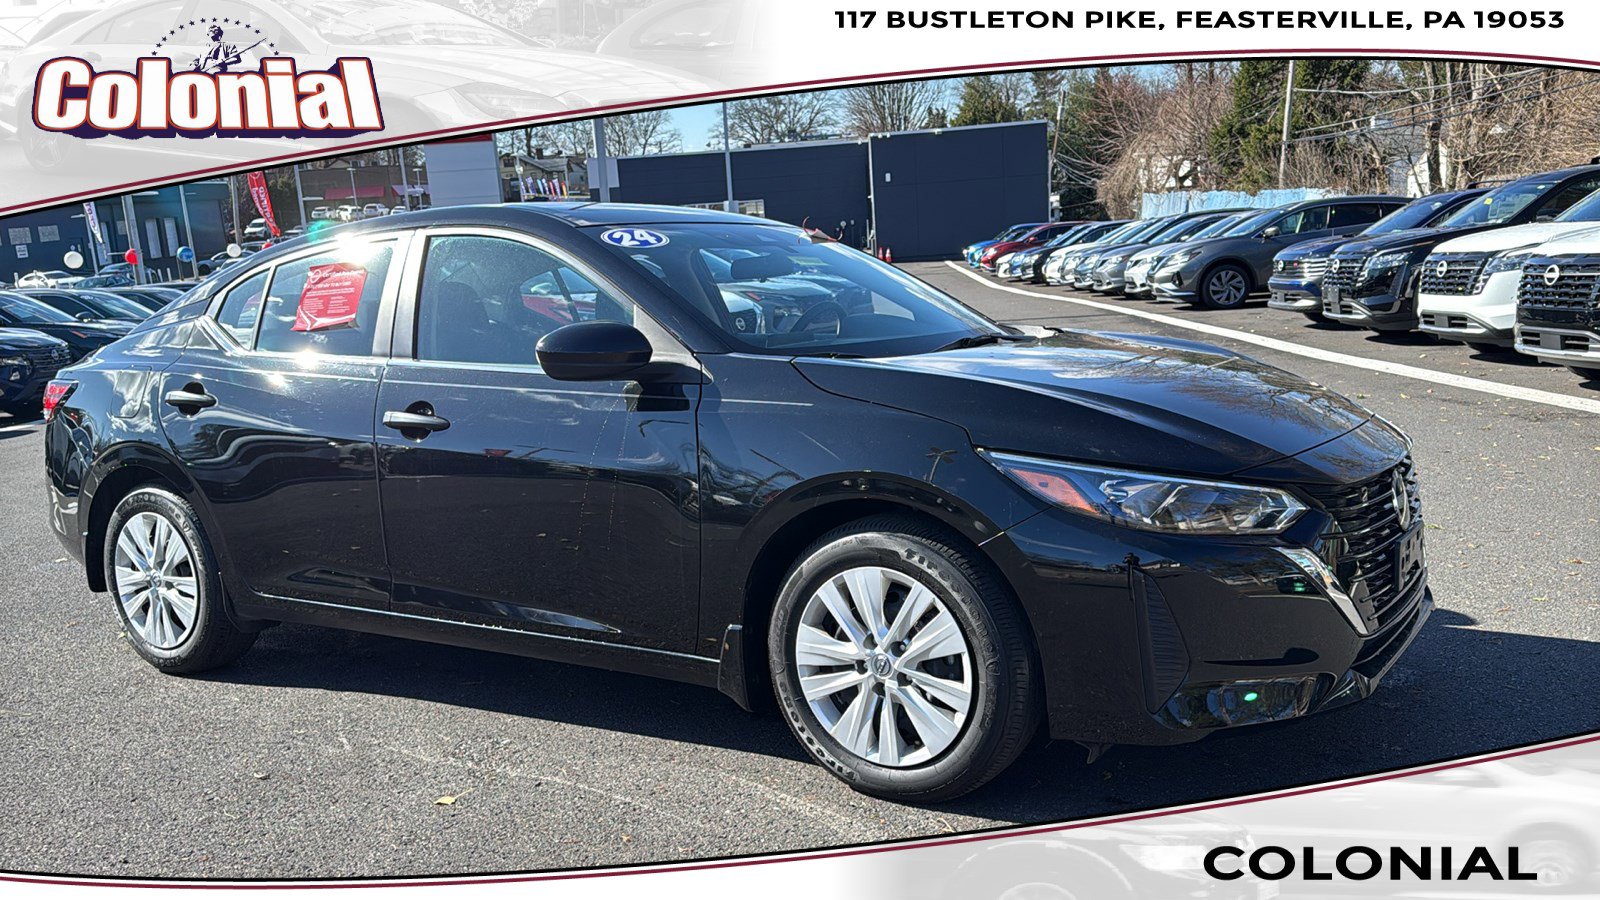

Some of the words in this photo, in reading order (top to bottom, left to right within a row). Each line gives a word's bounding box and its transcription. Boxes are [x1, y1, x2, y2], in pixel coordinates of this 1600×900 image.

[612, 230, 658, 247] 24
[904, 547, 996, 655] Firestone
[779, 680, 857, 782] Firestone
